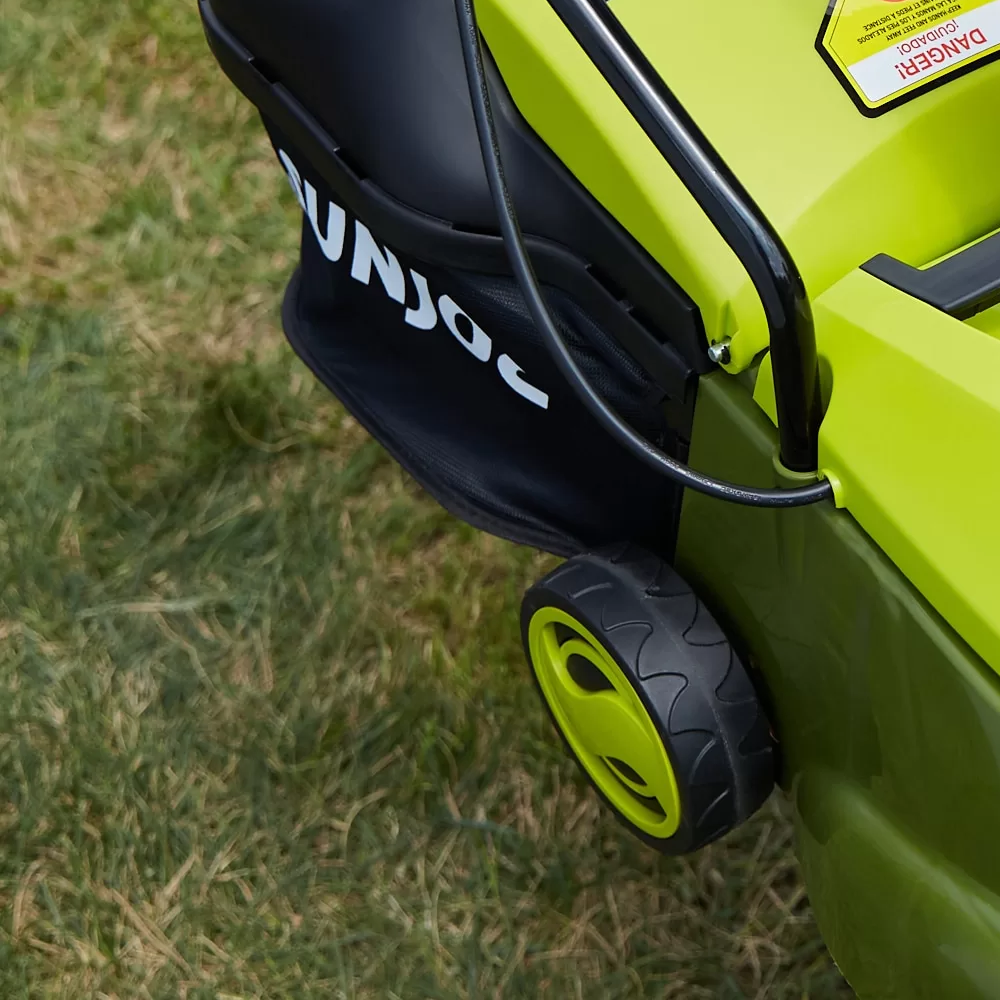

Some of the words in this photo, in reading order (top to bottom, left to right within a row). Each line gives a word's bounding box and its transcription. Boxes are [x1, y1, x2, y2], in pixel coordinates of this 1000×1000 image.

[935, 0, 946, 9] LAS
[946, 3, 961, 14] KEEP
[895, 5, 913, 16] PIEDS
[914, 5, 936, 18] MANOS
[926, 9, 947, 21] HANDS
[862, 15, 890, 31] DISTANCE
[885, 21, 899, 30] PIES
[898, 15, 911, 25] LOS
[914, 17, 928, 27] AND
[900, 23, 916, 33] FEET
[856, 26, 886, 44] ALEJADOS
[885, 29, 901, 41] AWAY
[896, 18, 959, 55] ¡CUIDADO!
[893, 27, 987, 80] DANGER!
